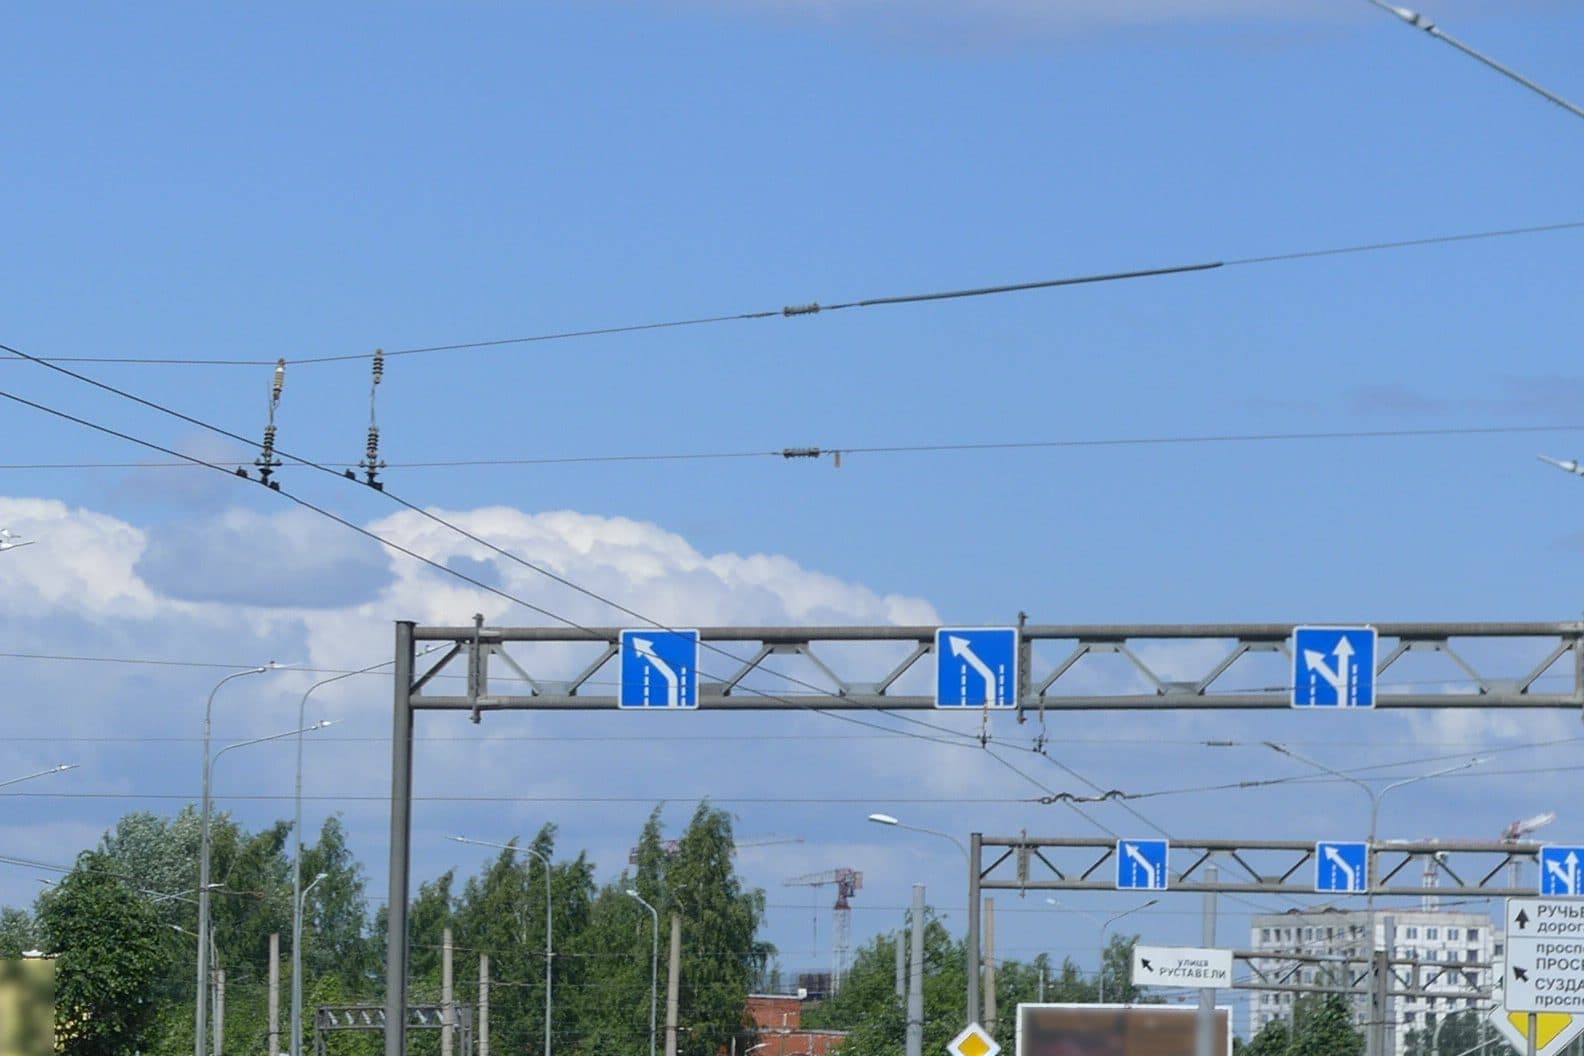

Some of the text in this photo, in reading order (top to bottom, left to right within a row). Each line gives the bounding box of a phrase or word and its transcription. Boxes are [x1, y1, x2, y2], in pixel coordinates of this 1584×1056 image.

[1536, 944, 1584, 956] просп
[1177, 959, 1209, 969] улица
[1159, 967, 1226, 979] РУСТАВЕЛИ
[1535, 996, 1584, 1008] просп
